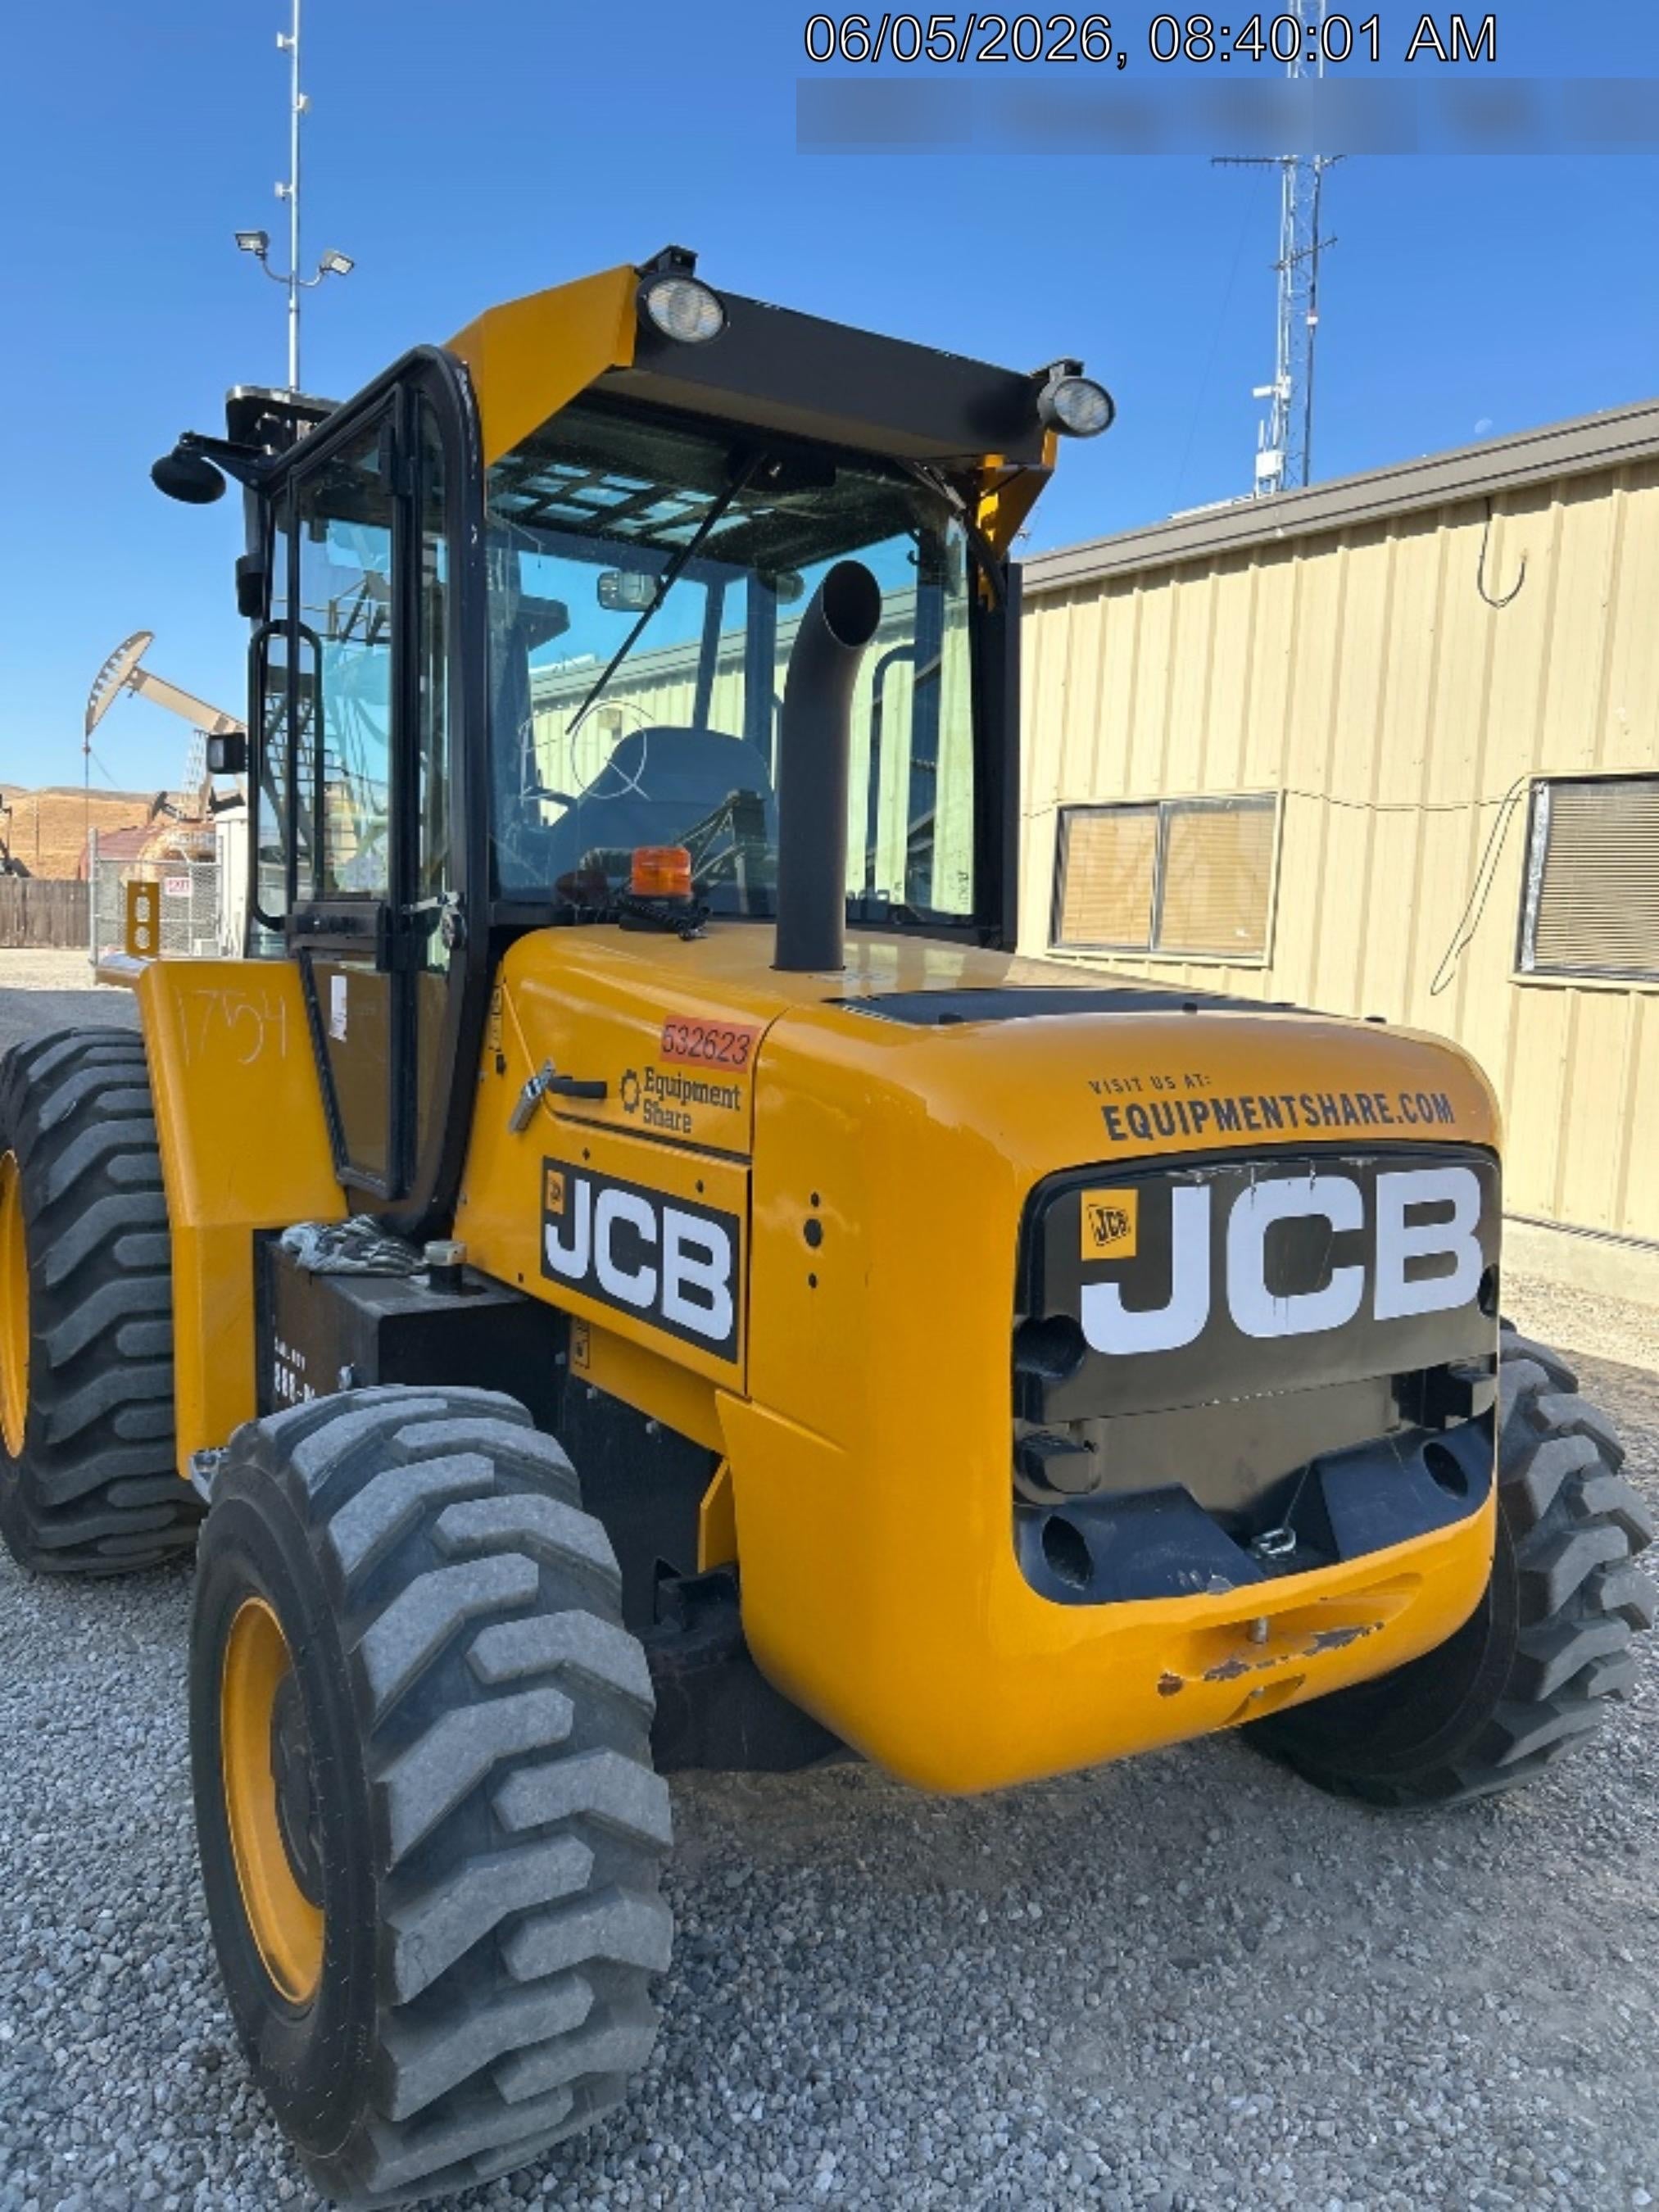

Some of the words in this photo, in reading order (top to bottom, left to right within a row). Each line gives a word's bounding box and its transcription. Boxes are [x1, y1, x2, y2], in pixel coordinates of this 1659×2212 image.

[662, 1024, 751, 1064] 532623
[643, 1067, 741, 1110] Equipment
[1089, 1077, 1143, 1094] VISIT
[1150, 1076, 1176, 1090] US
[1184, 1073, 1211, 1089] AT:
[643, 1099, 691, 1134] Share
[1101, 1093, 1455, 1140] EQUIPMENTSHARE.COM
[1095, 1208, 1127, 1242] JCB
[545, 1179, 734, 1340] JCB
[1081, 1167, 1483, 1355] JCB
